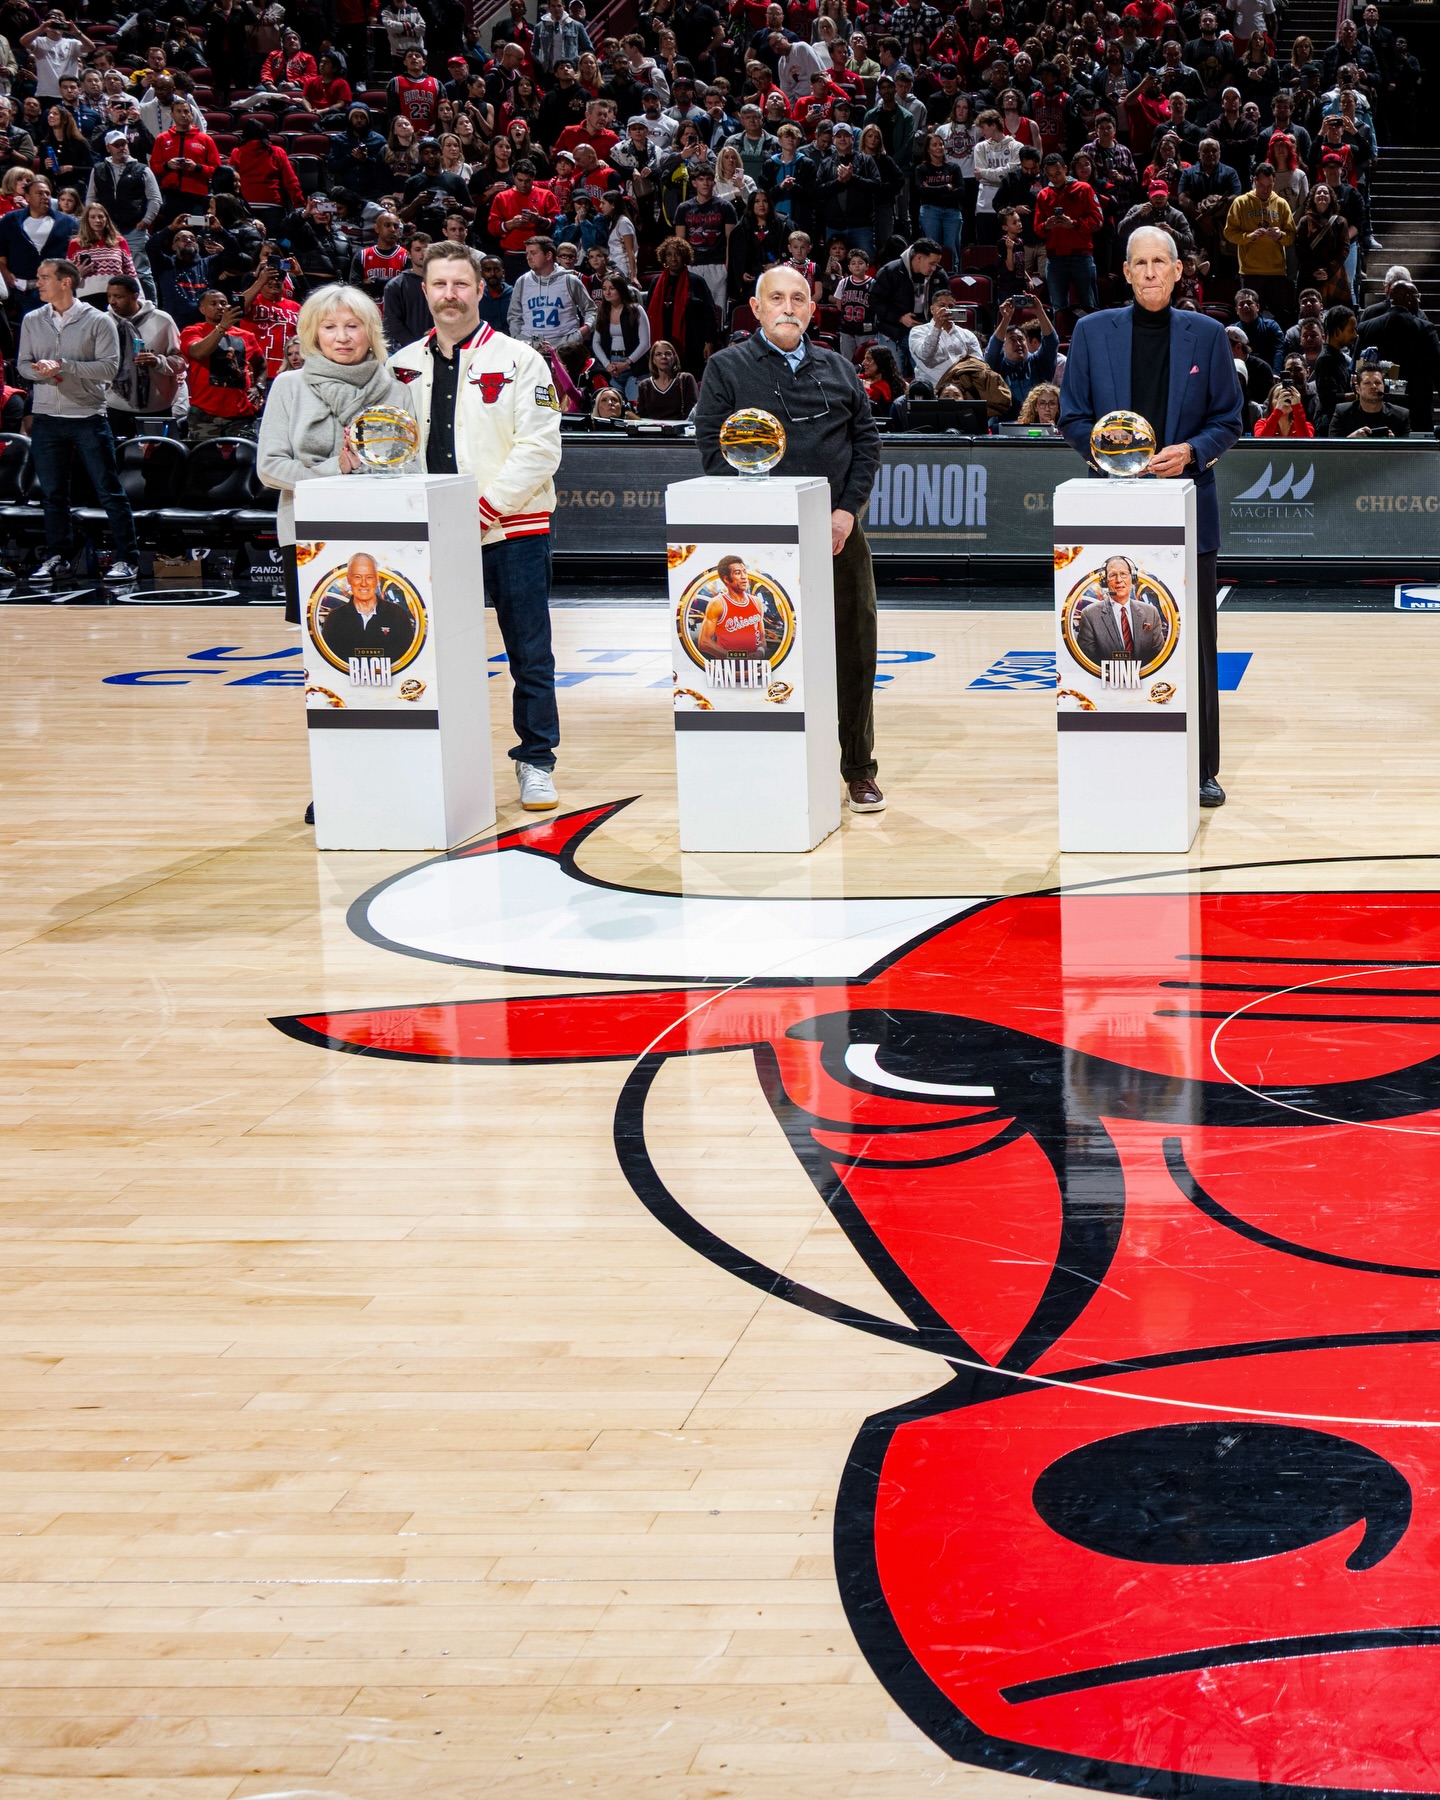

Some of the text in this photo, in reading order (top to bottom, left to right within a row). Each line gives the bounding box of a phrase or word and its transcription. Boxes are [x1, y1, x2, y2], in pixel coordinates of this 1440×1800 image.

[404, 90, 434, 104] BULLS
[410, 103, 430, 120] 23
[1040, 120, 1059, 135] 23
[528, 296, 565, 310] UCLA
[842, 289, 870, 307] BULLS
[532, 309, 561, 328] 24
[843, 305, 866, 322] 33
[869, 464, 987, 526] HONOR
[1230, 507, 1315, 519] MAGELLAN
[348, 657, 392, 687] BACH
[704, 659, 772, 689] VAN LIER
[1100, 660, 1142, 689] FUNK
